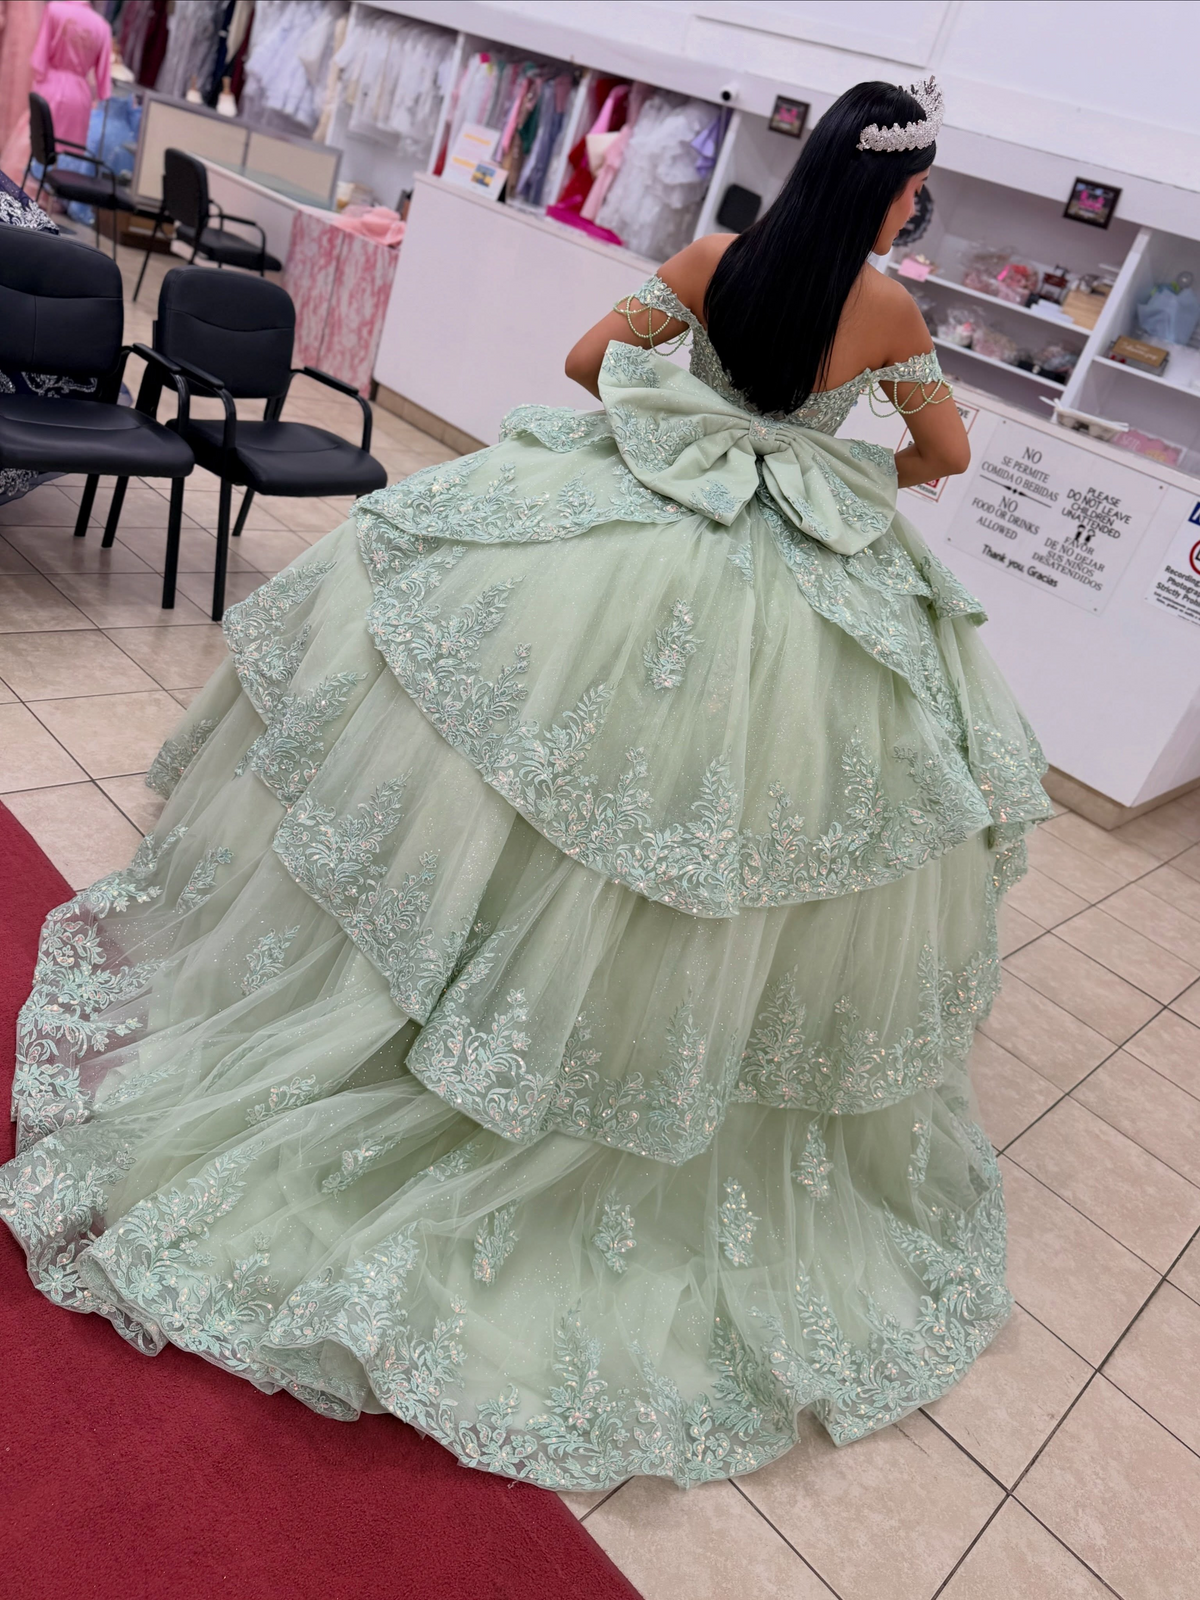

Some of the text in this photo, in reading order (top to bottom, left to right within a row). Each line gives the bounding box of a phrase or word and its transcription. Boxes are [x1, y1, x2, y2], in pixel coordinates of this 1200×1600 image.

[1022, 446, 1042, 464] NO
[981, 461, 1059, 502] COMIDA O BEBIDAS
[1001, 455, 1050, 483] SE PERMITE
[998, 495, 1019, 513] NO
[1066, 488, 1132, 525] DO NOT LEAVE
[1086, 486, 1122, 508] PLEASE
[971, 497, 1040, 535] FOOD OR DRINKS
[1061, 507, 1121, 539] UNATTENDED
[1070, 502, 1115, 527] CHILDREN
[976, 516, 1018, 540] ALLOWED
[1043, 537, 1105, 572] DE NO DEJAR
[1046, 550, 1064, 563] SUS
[1063, 536, 1095, 556] FAVOR
[981, 543, 1006, 563] Thank
[1026, 565, 1058, 588] Gracias
[1031, 551, 1103, 591] DESATENDIDOS
[1155, 581, 1182, 599] Strictly
